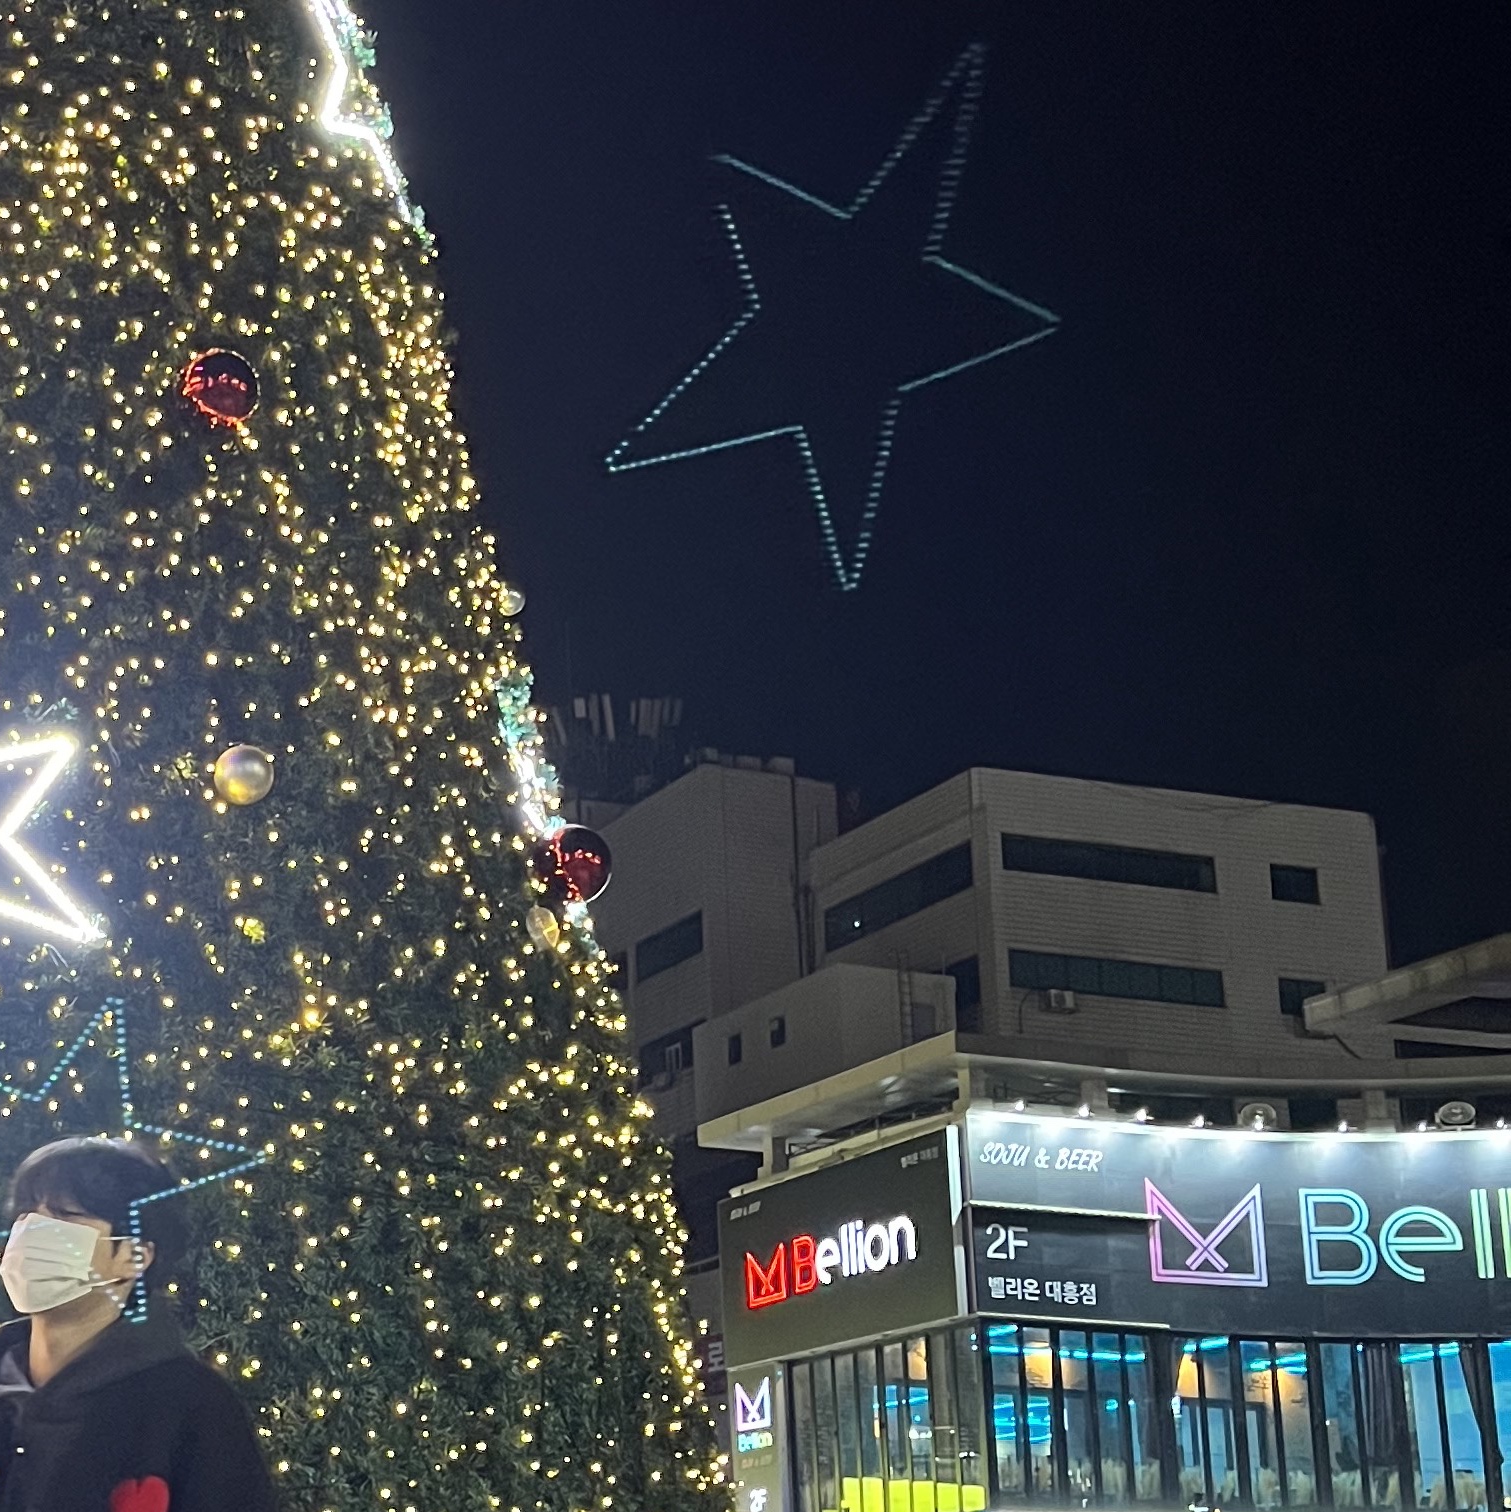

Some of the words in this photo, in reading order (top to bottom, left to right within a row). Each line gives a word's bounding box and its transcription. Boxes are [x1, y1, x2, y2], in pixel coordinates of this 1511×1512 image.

[980, 1141, 1031, 1167] SOJU
[1034, 1147, 1051, 1169] &
[1054, 1147, 1104, 1173] BEER
[791, 1213, 920, 1297] Bellion
[985, 1222, 1029, 1261] 2F
[988, 1276, 1041, 1301] 벨리온
[1044, 1280, 1097, 1305] 대흥점
